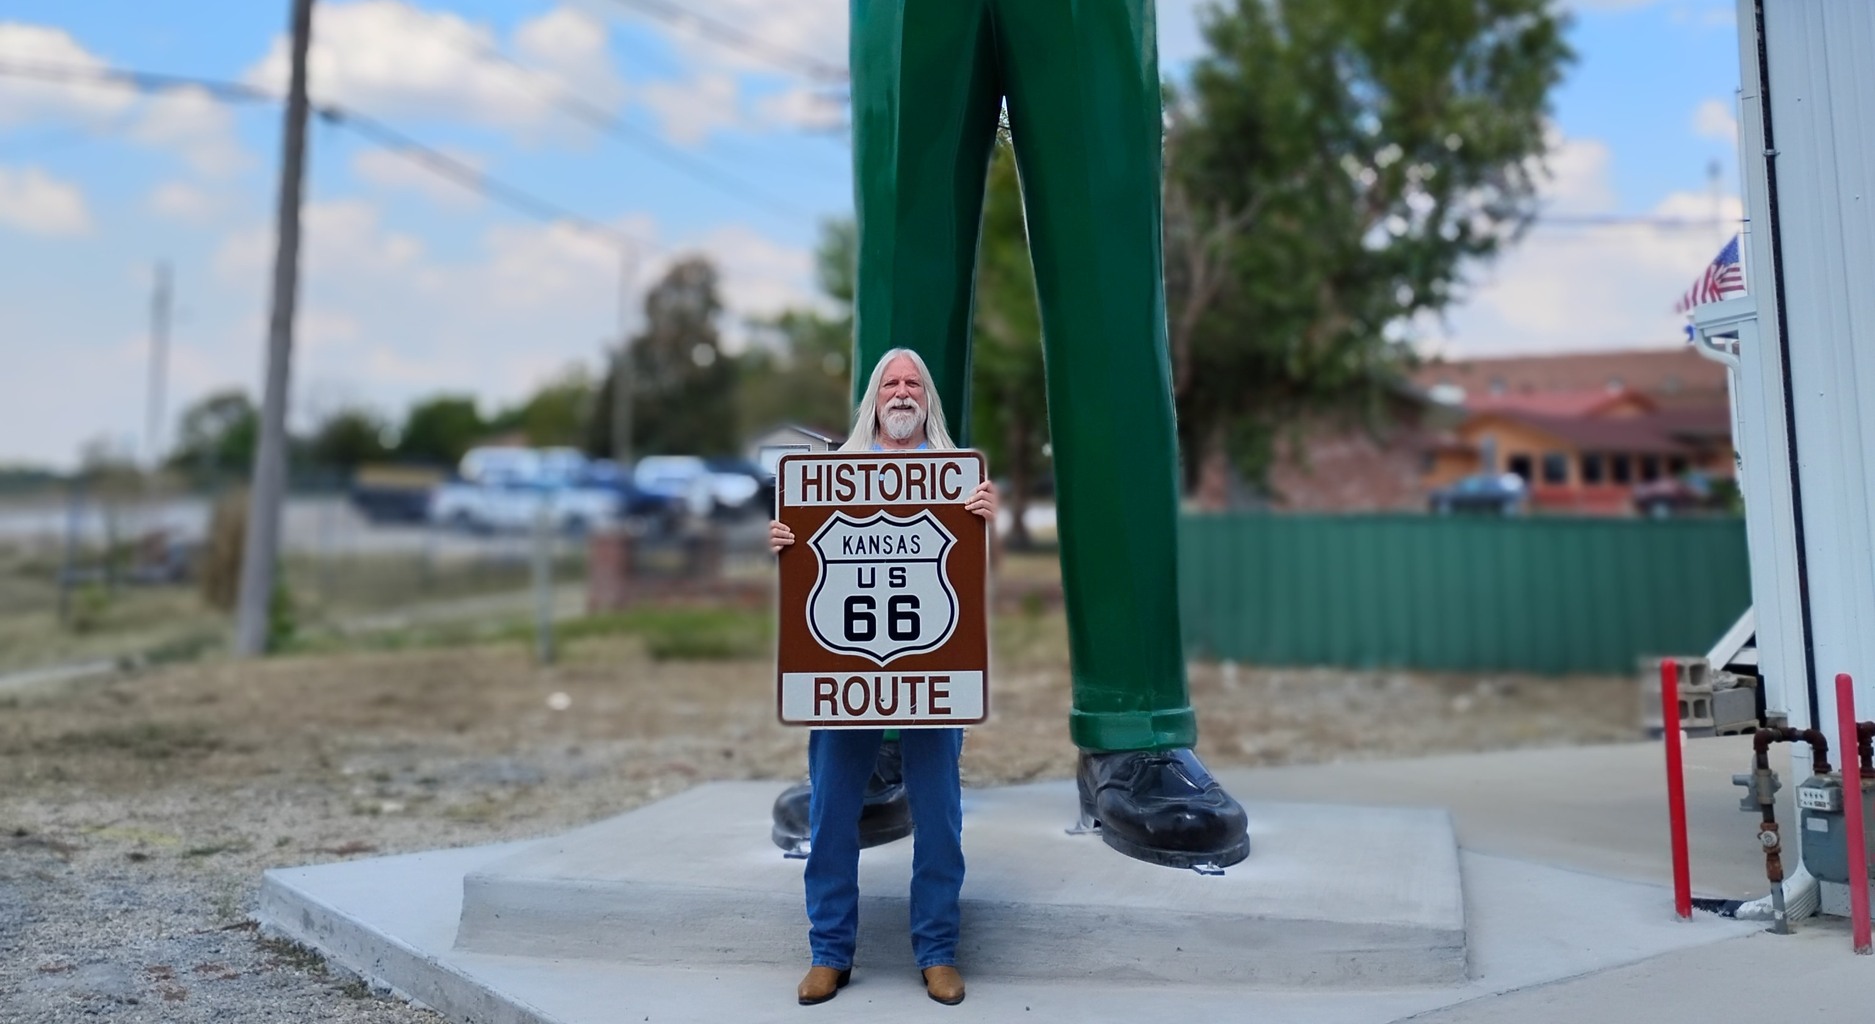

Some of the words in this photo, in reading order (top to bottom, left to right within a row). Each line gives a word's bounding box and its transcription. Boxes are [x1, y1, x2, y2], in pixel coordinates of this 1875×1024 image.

[801, 462, 962, 502] HISTORIC
[842, 534, 921, 555] KANSAS
[843, 594, 921, 642] 66
[813, 675, 952, 717] ROUTE
